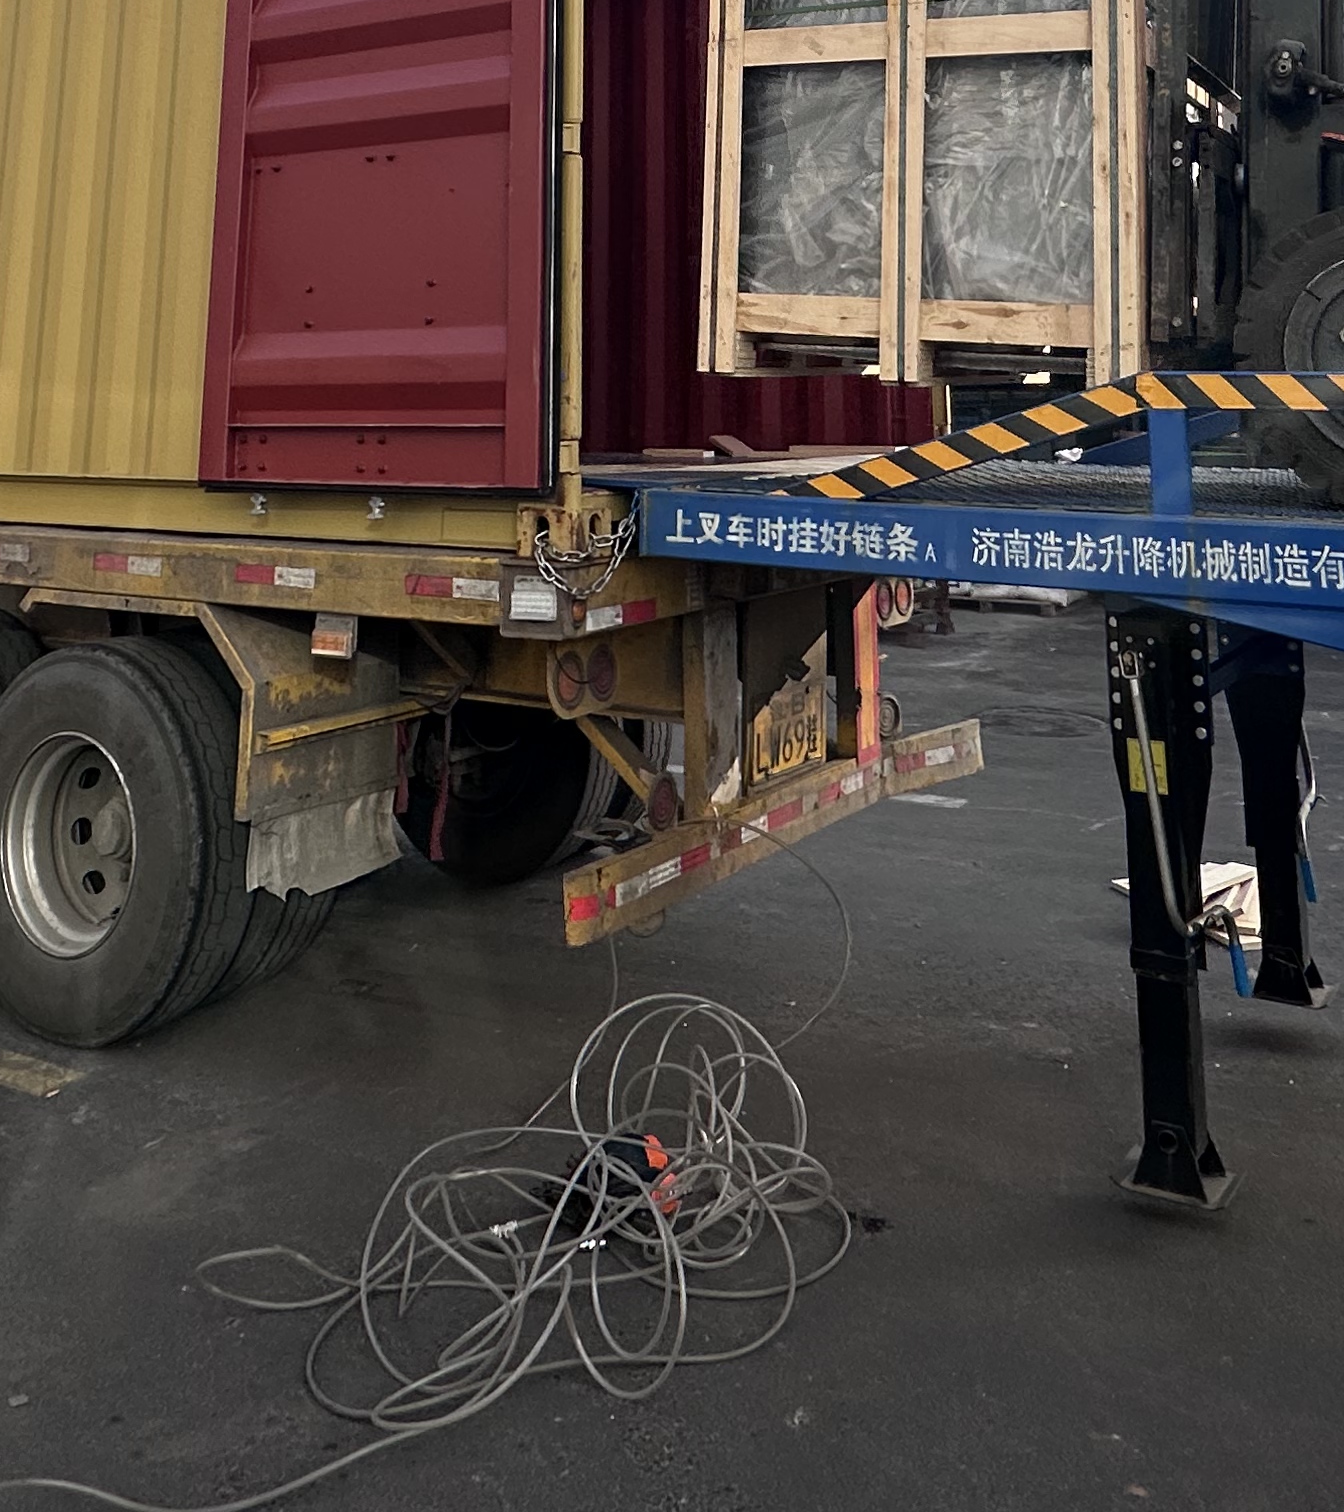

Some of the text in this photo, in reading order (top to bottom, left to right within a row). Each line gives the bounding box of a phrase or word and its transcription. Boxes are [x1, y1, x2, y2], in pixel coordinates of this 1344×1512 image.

[665, 508, 920, 563] 上叉车时挂好链条
